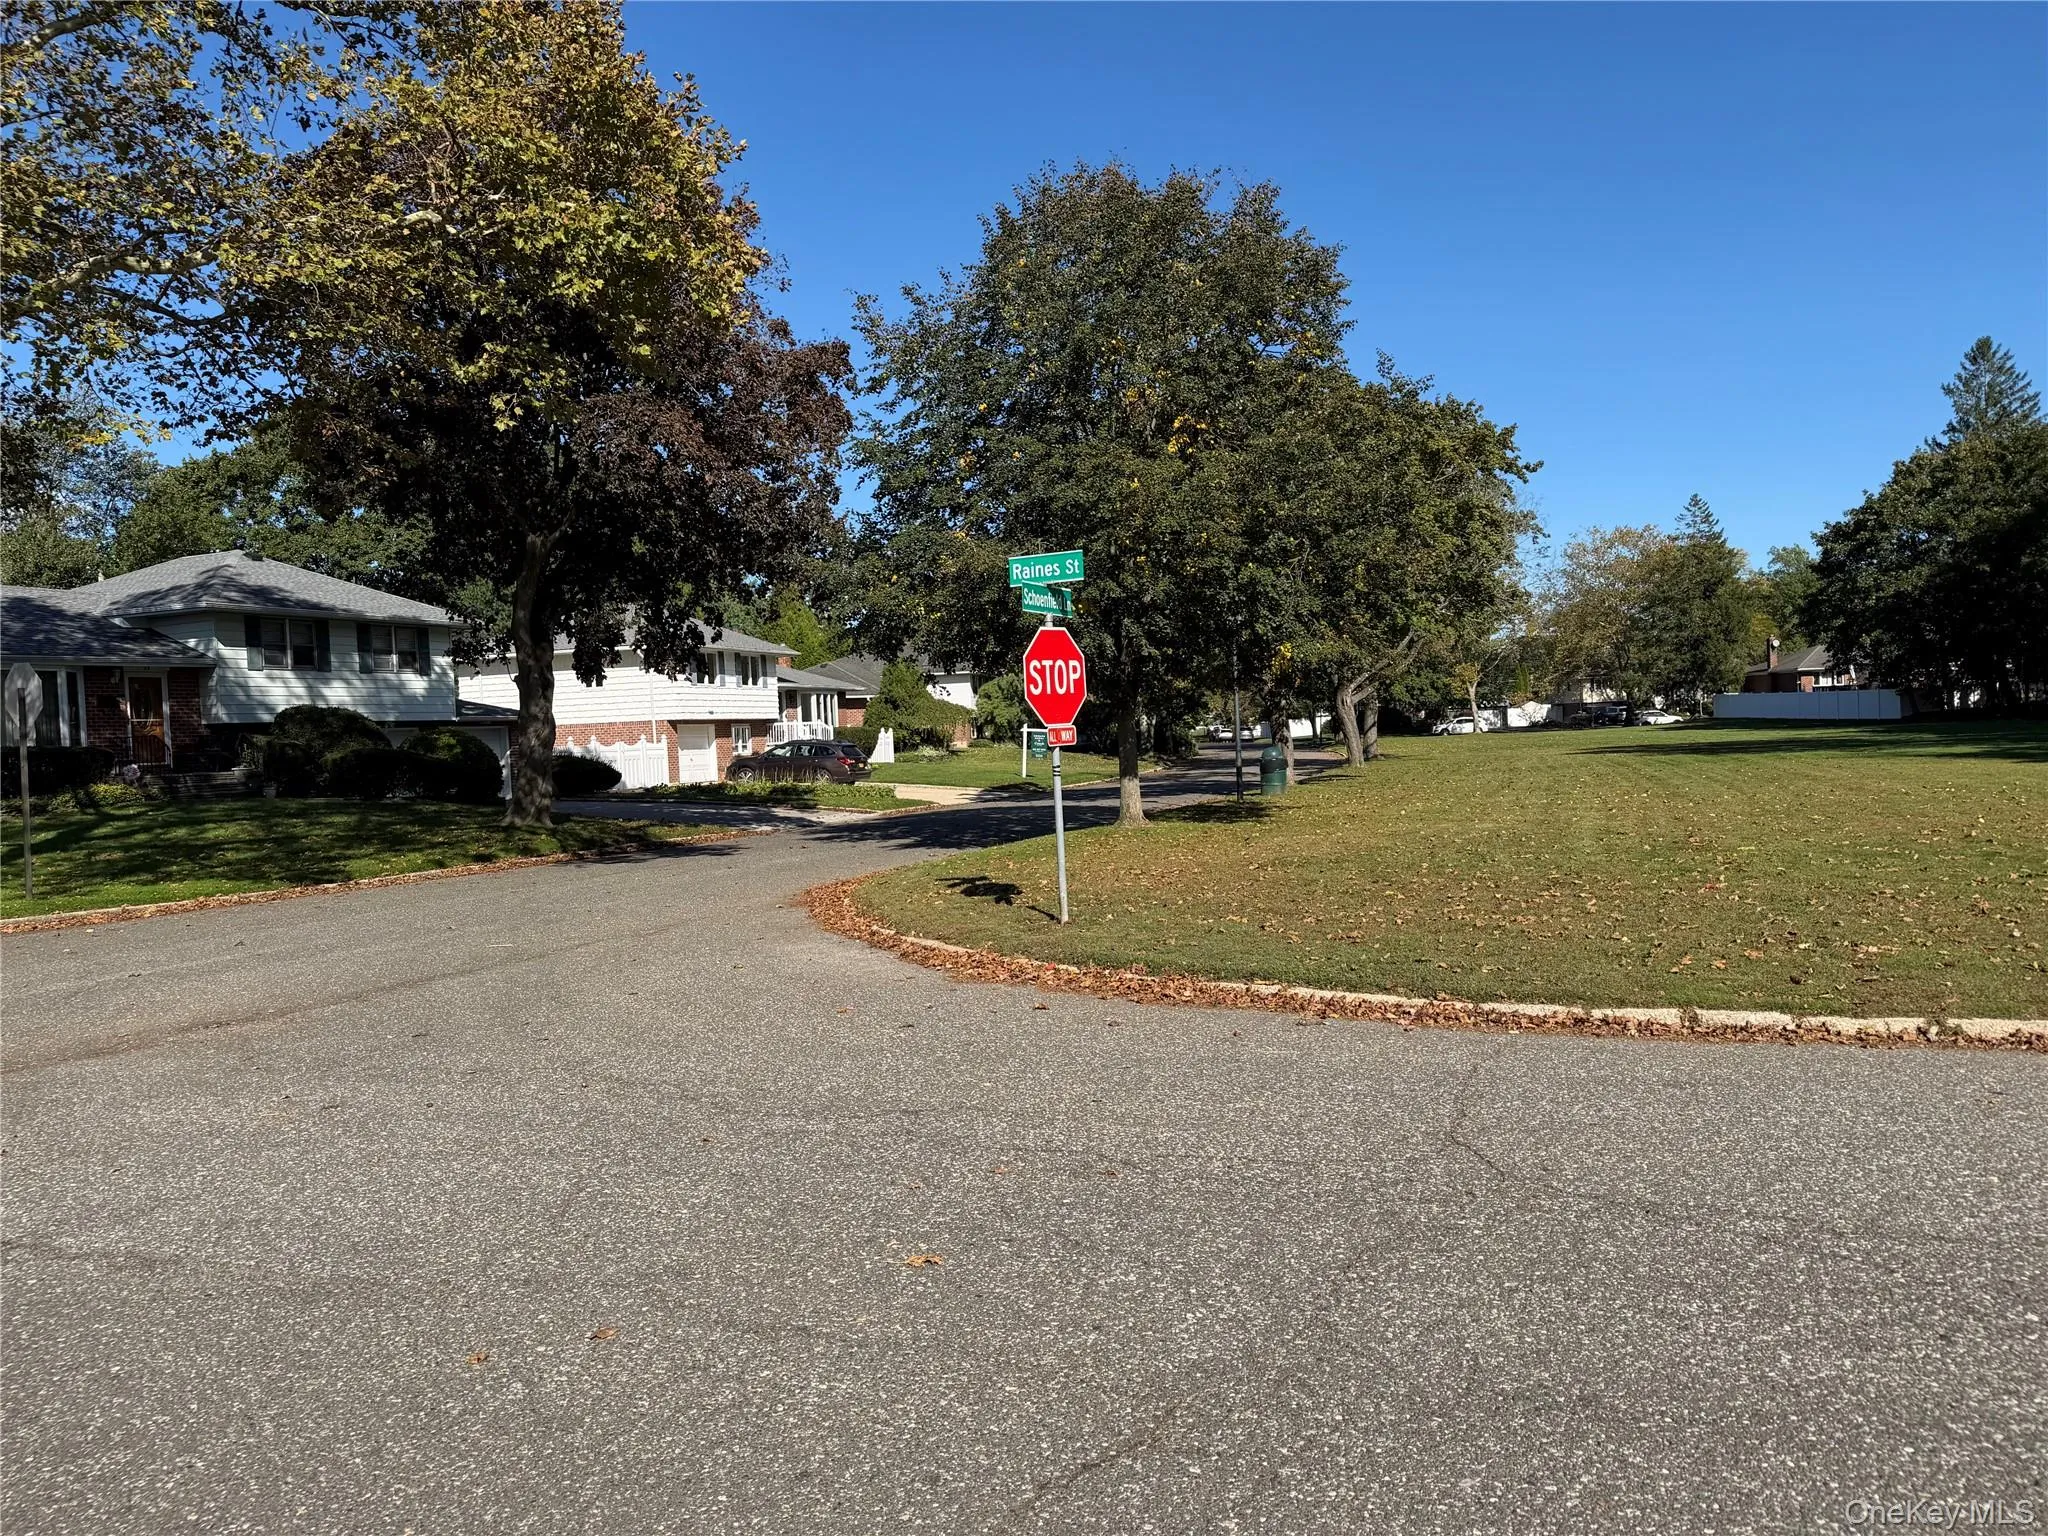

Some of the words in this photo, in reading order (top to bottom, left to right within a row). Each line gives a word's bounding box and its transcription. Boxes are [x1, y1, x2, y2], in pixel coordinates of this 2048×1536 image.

[1012, 561, 1061, 580] Raines
[1065, 559, 1080, 575] St
[1029, 659, 1082, 696] STOP
[1060, 729, 1074, 742] WAY
